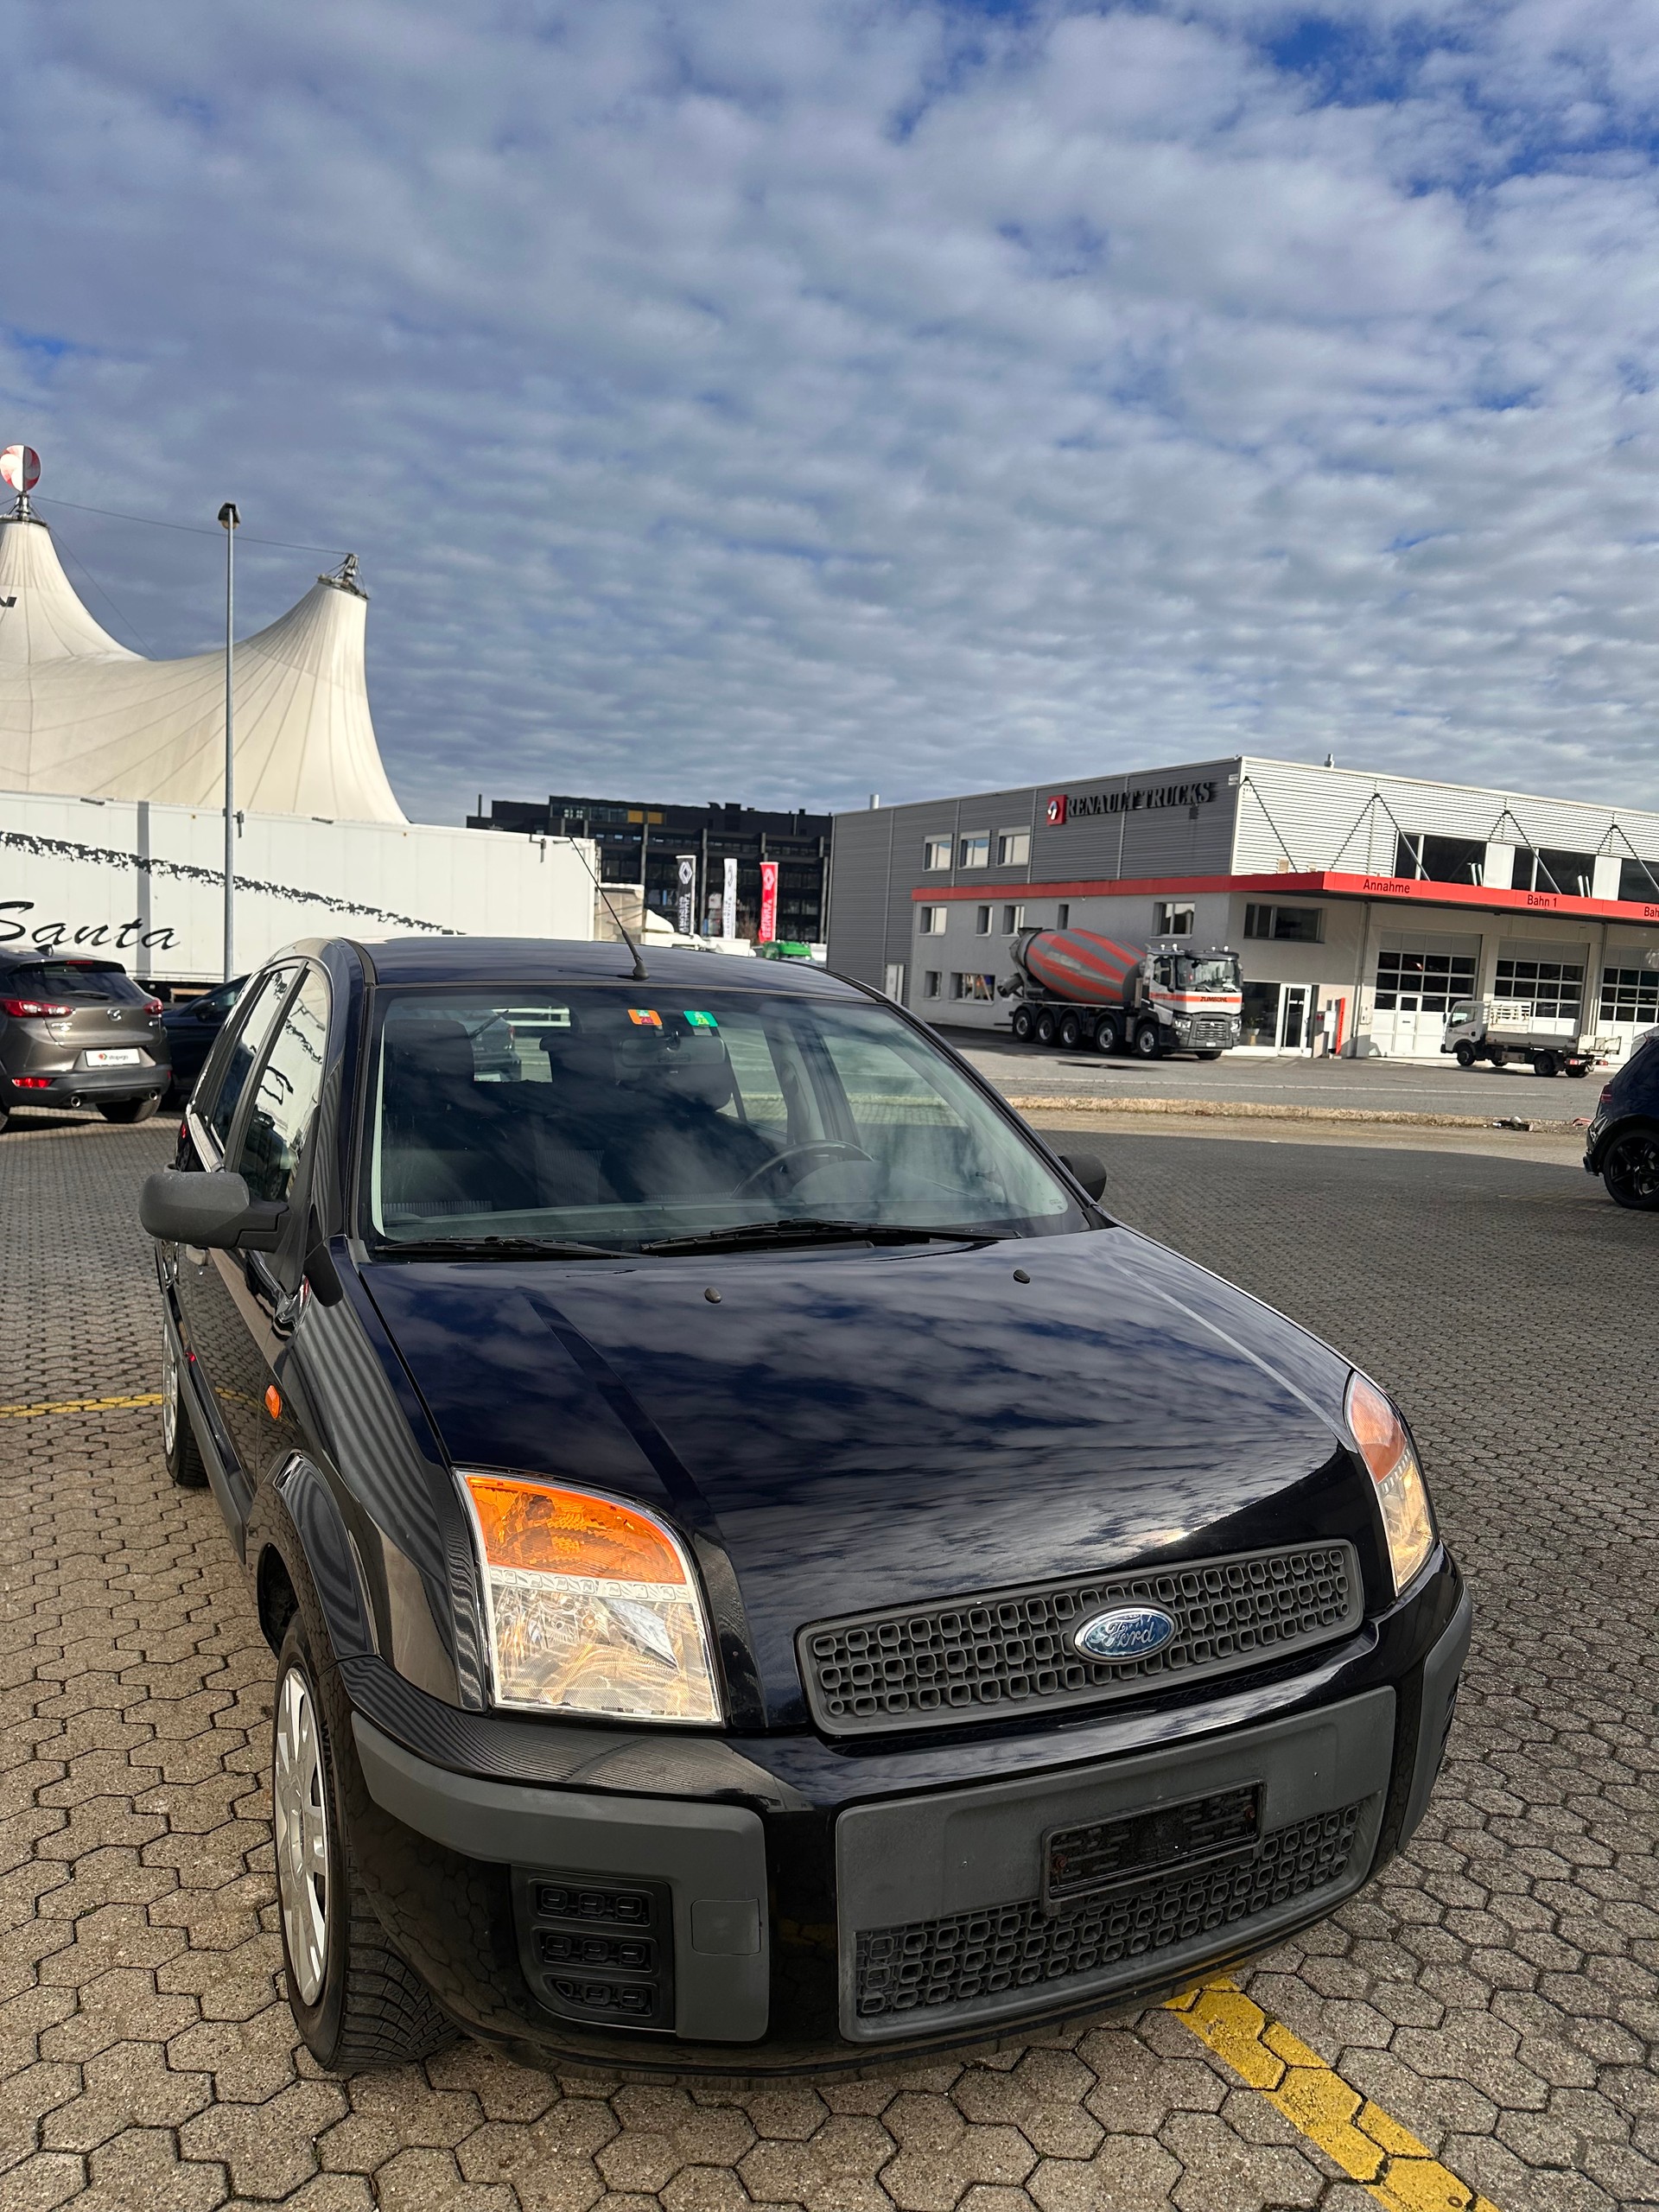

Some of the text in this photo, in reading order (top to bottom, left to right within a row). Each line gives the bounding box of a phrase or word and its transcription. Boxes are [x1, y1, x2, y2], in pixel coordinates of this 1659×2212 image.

[1067, 782, 1210, 817] RENAULT TRUCKS
[1363, 879, 1411, 894] Annahme
[1527, 894, 1558, 908] Bahn 1
[1102, 1618, 1156, 1648] Ford
